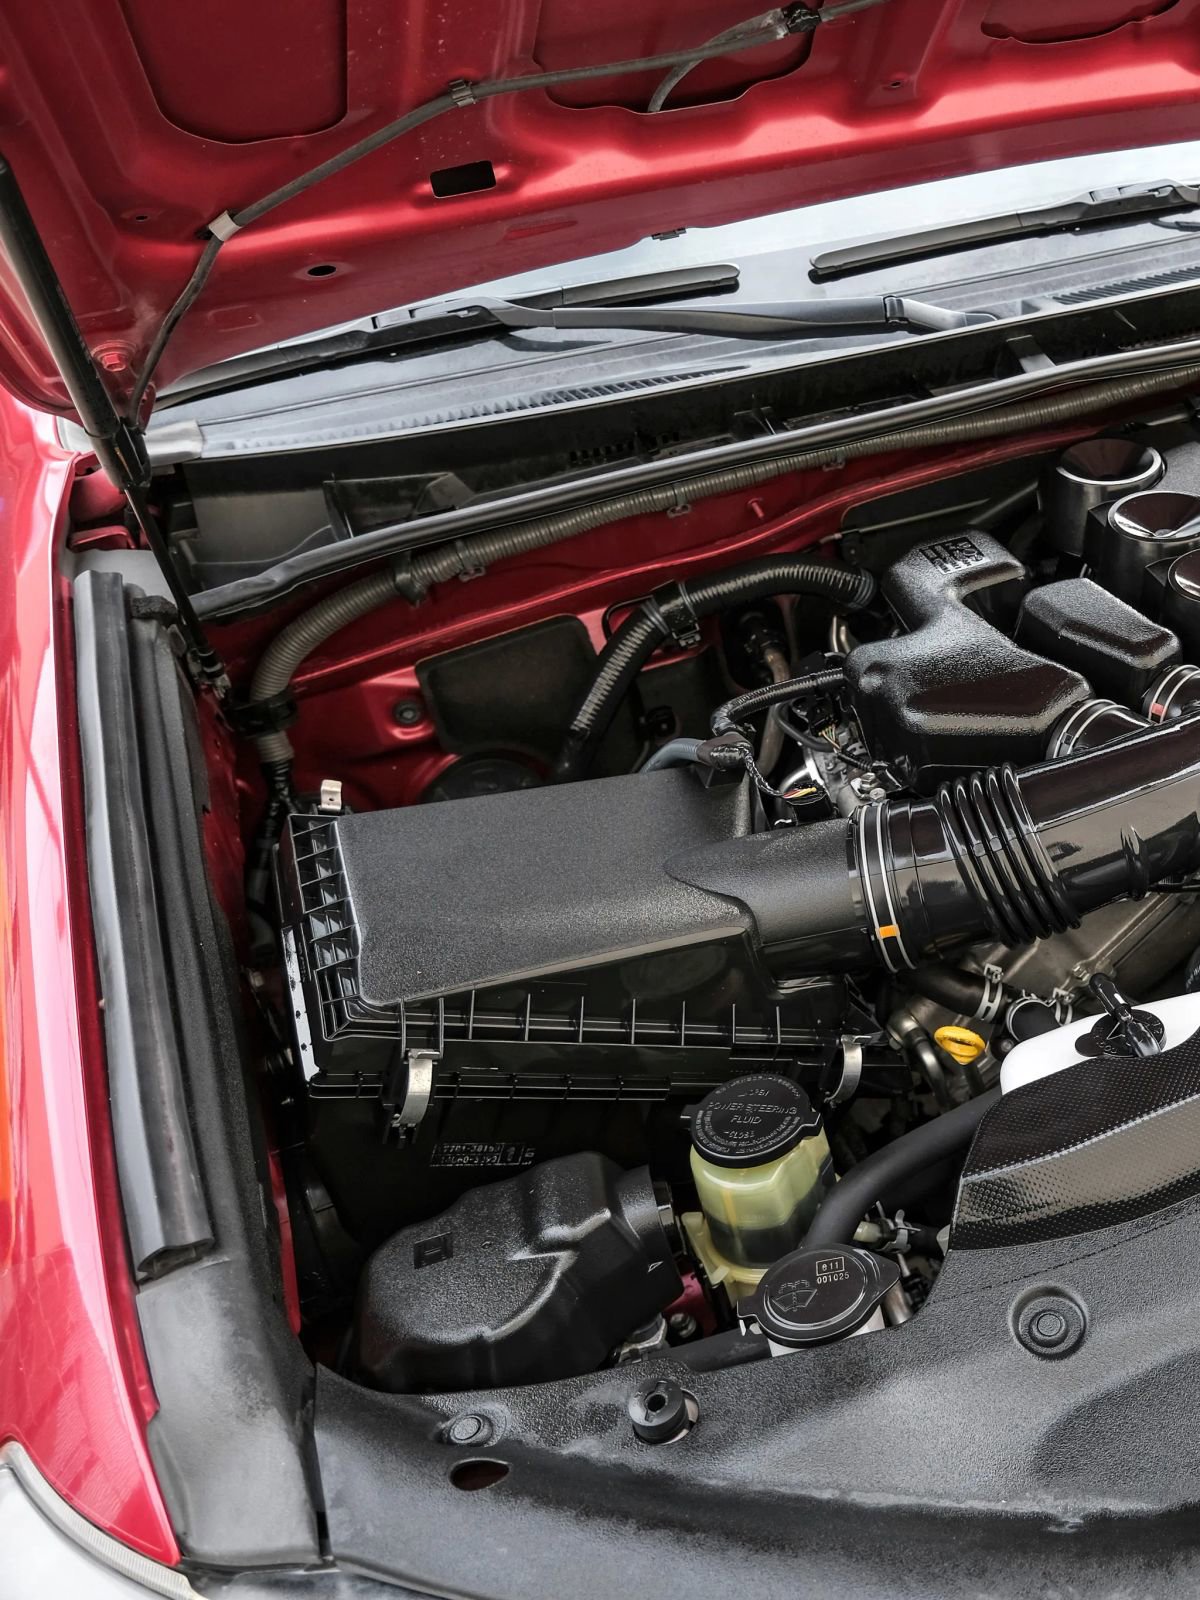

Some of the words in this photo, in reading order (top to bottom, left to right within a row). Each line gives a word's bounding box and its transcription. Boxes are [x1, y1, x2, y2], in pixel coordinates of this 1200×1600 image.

[707, 1101, 744, 1112] POWER
[745, 1103, 798, 1115] STEERING
[730, 1115, 762, 1125] FLUID
[822, 1261, 839, 1271] e11
[817, 1272, 850, 1285] 001025
